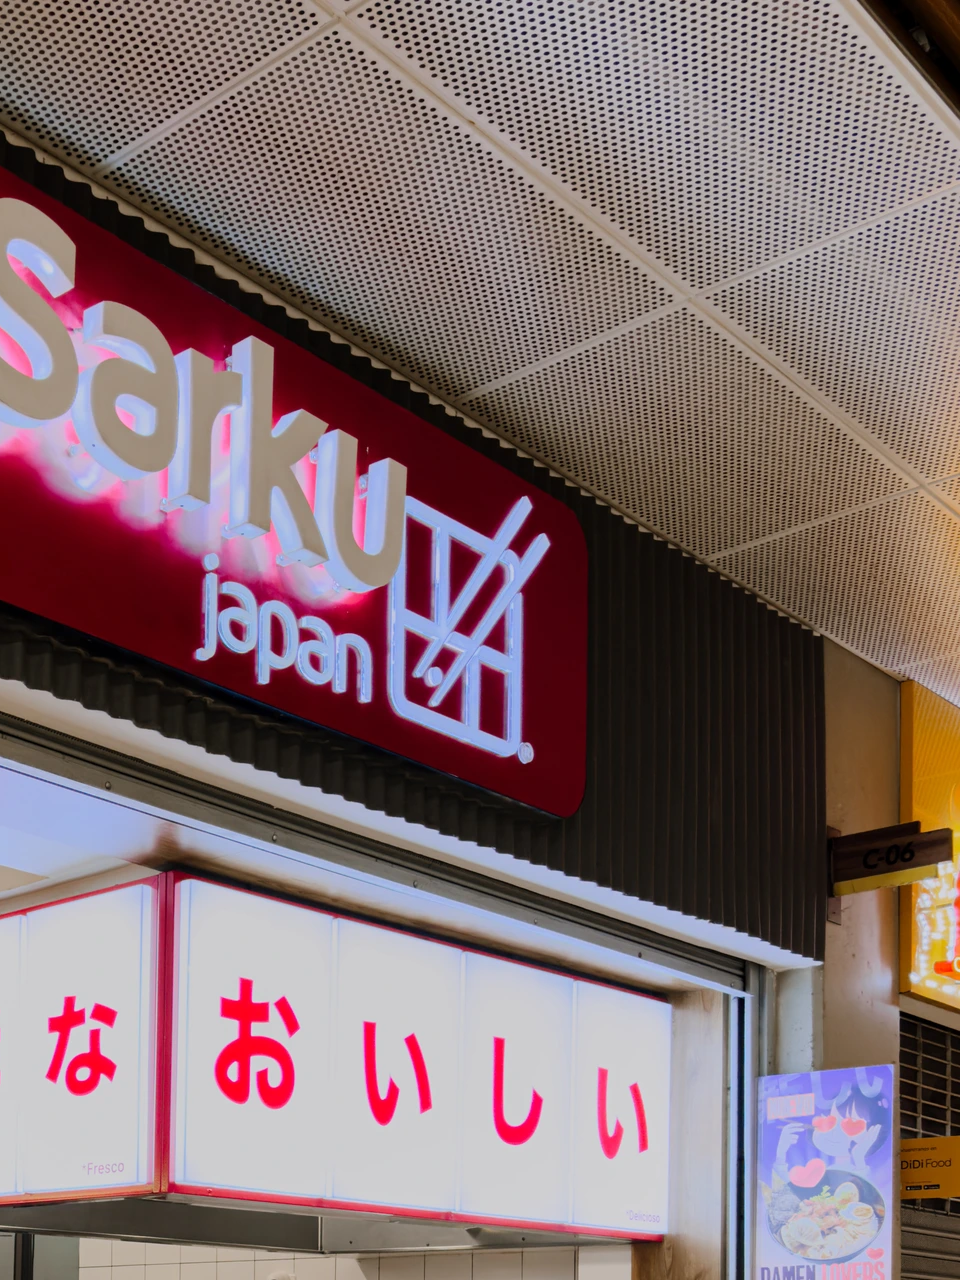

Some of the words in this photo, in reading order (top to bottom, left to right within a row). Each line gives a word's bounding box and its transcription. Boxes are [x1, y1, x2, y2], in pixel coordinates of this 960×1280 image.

[195, 553, 373, 703] japan
[862, 841, 916, 870] C-06
[214, 977, 649, 1159] おいしい
[900, 1159, 924, 1170] DiDi
[925, 1158, 952, 1168] Food
